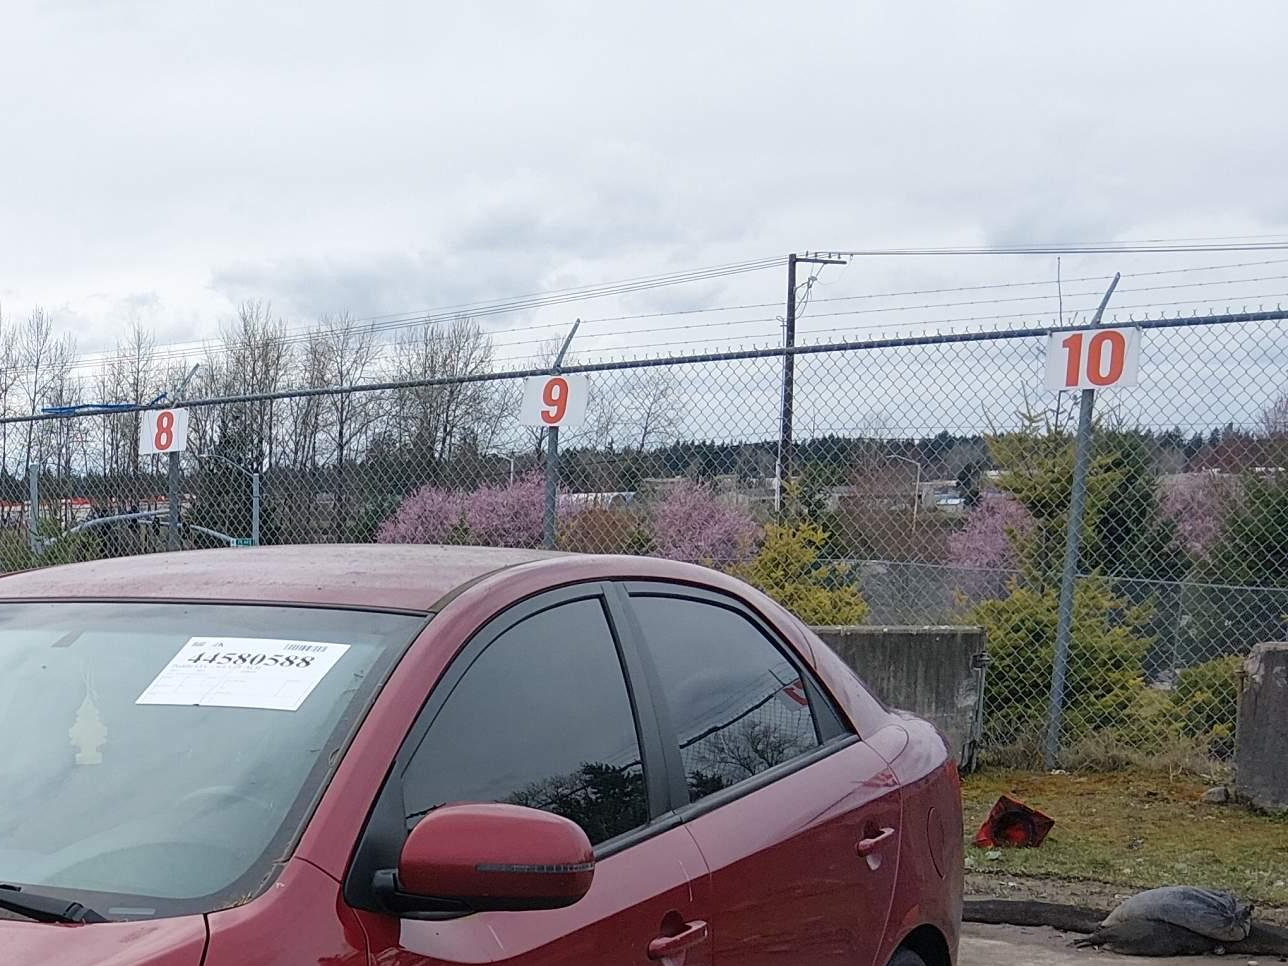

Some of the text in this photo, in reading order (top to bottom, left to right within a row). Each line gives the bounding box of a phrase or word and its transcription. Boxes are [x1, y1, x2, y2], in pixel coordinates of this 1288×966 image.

[1062, 330, 1126, 388] 10
[540, 377, 569, 425] 9
[154, 411, 175, 451] 8
[187, 651, 316, 669] 44580588
